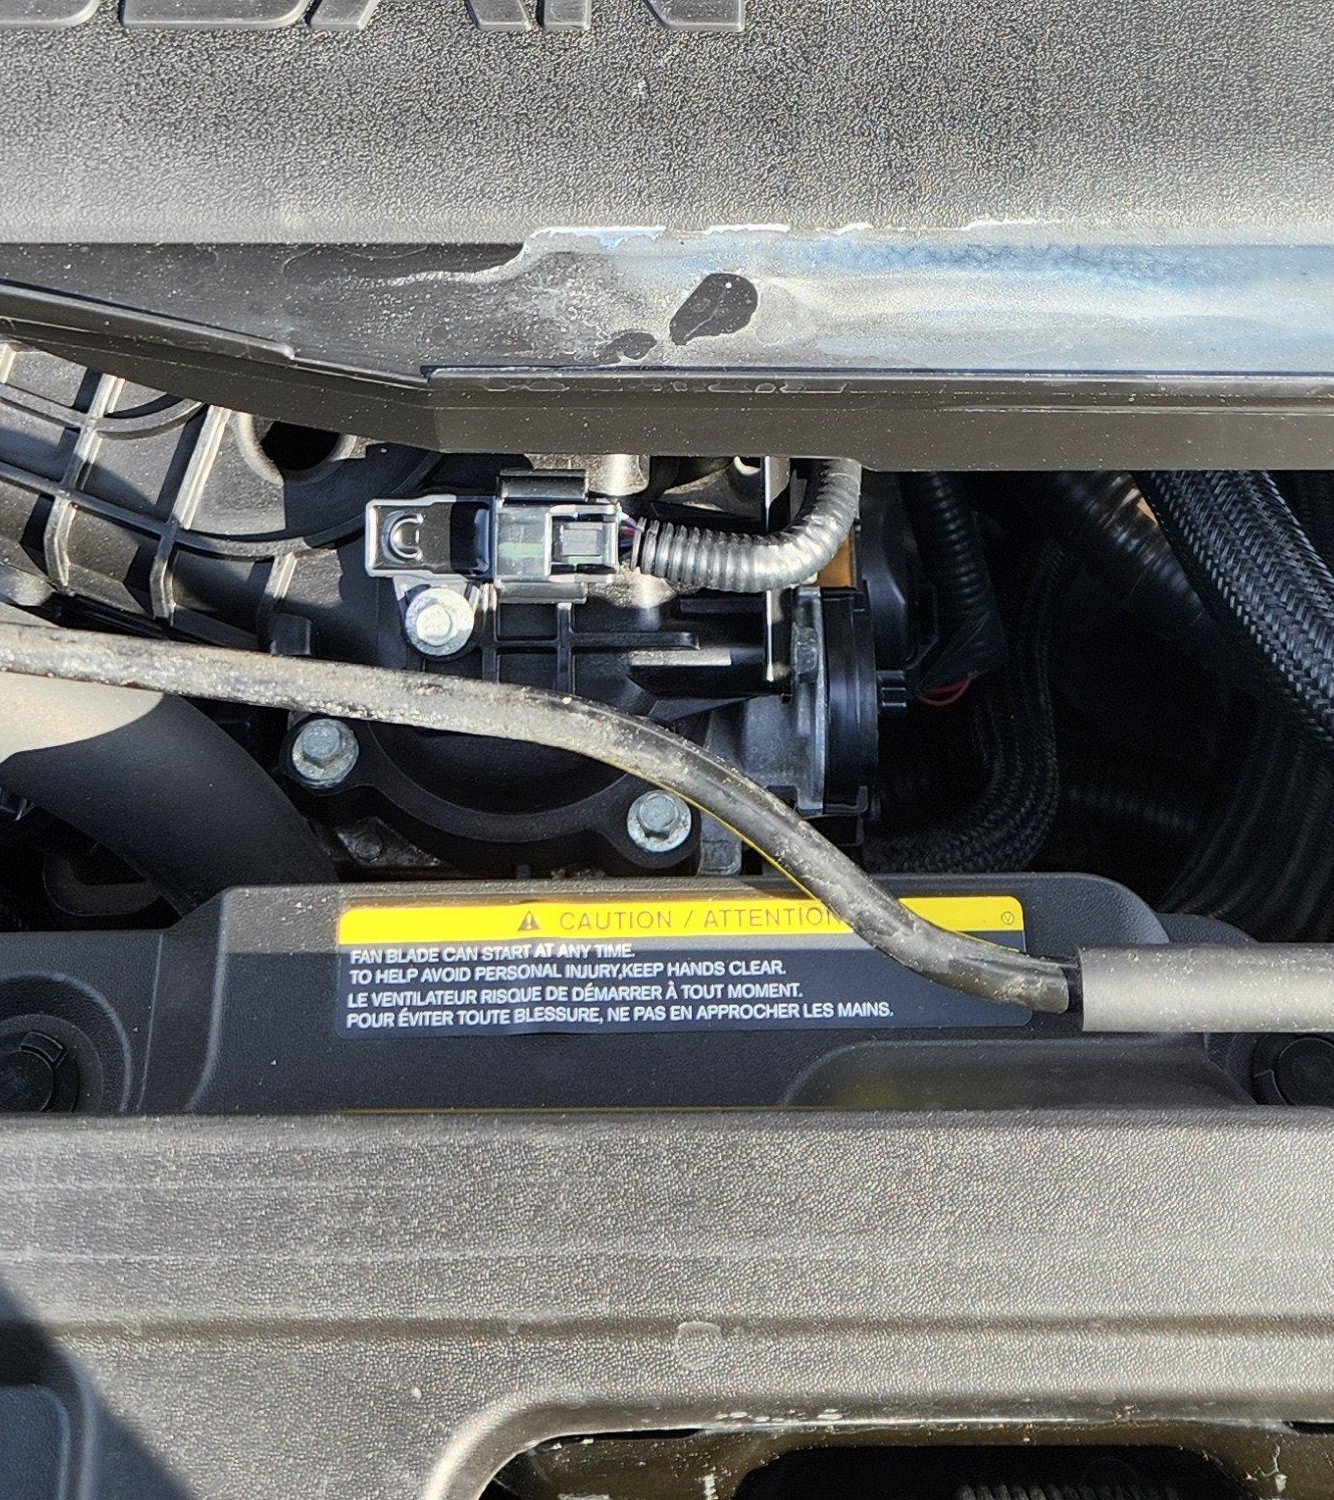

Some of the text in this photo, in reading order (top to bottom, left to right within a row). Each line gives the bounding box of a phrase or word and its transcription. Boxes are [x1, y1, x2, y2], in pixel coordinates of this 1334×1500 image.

[559, 910, 672, 930] CAUTION
[350, 943, 636, 964] FAN BLADE CAN START AT ANY TIME.
[349, 969, 373, 985] TO
[375, 968, 419, 984] HELP
[420, 967, 472, 983] AVOID
[474, 963, 563, 981] PERSONAL
[667, 960, 725, 977] HANDS
[728, 960, 787, 976] CLEAR.
[347, 993, 368, 1008] LE
[371, 989, 478, 1007] VENTILATEUR
[480, 986, 542, 1004] RISQUE
[545, 986, 568, 1001] DE
[572, 982, 663, 1002] DÉMARRER
[680, 984, 725, 999] TOUT
[727, 982, 803, 998] MOMENT.
[346, 1001, 895, 1028] POUR ÉVITER TOUTE BLESSURE, NE PAS EN APPROCHER LES MAINS.
